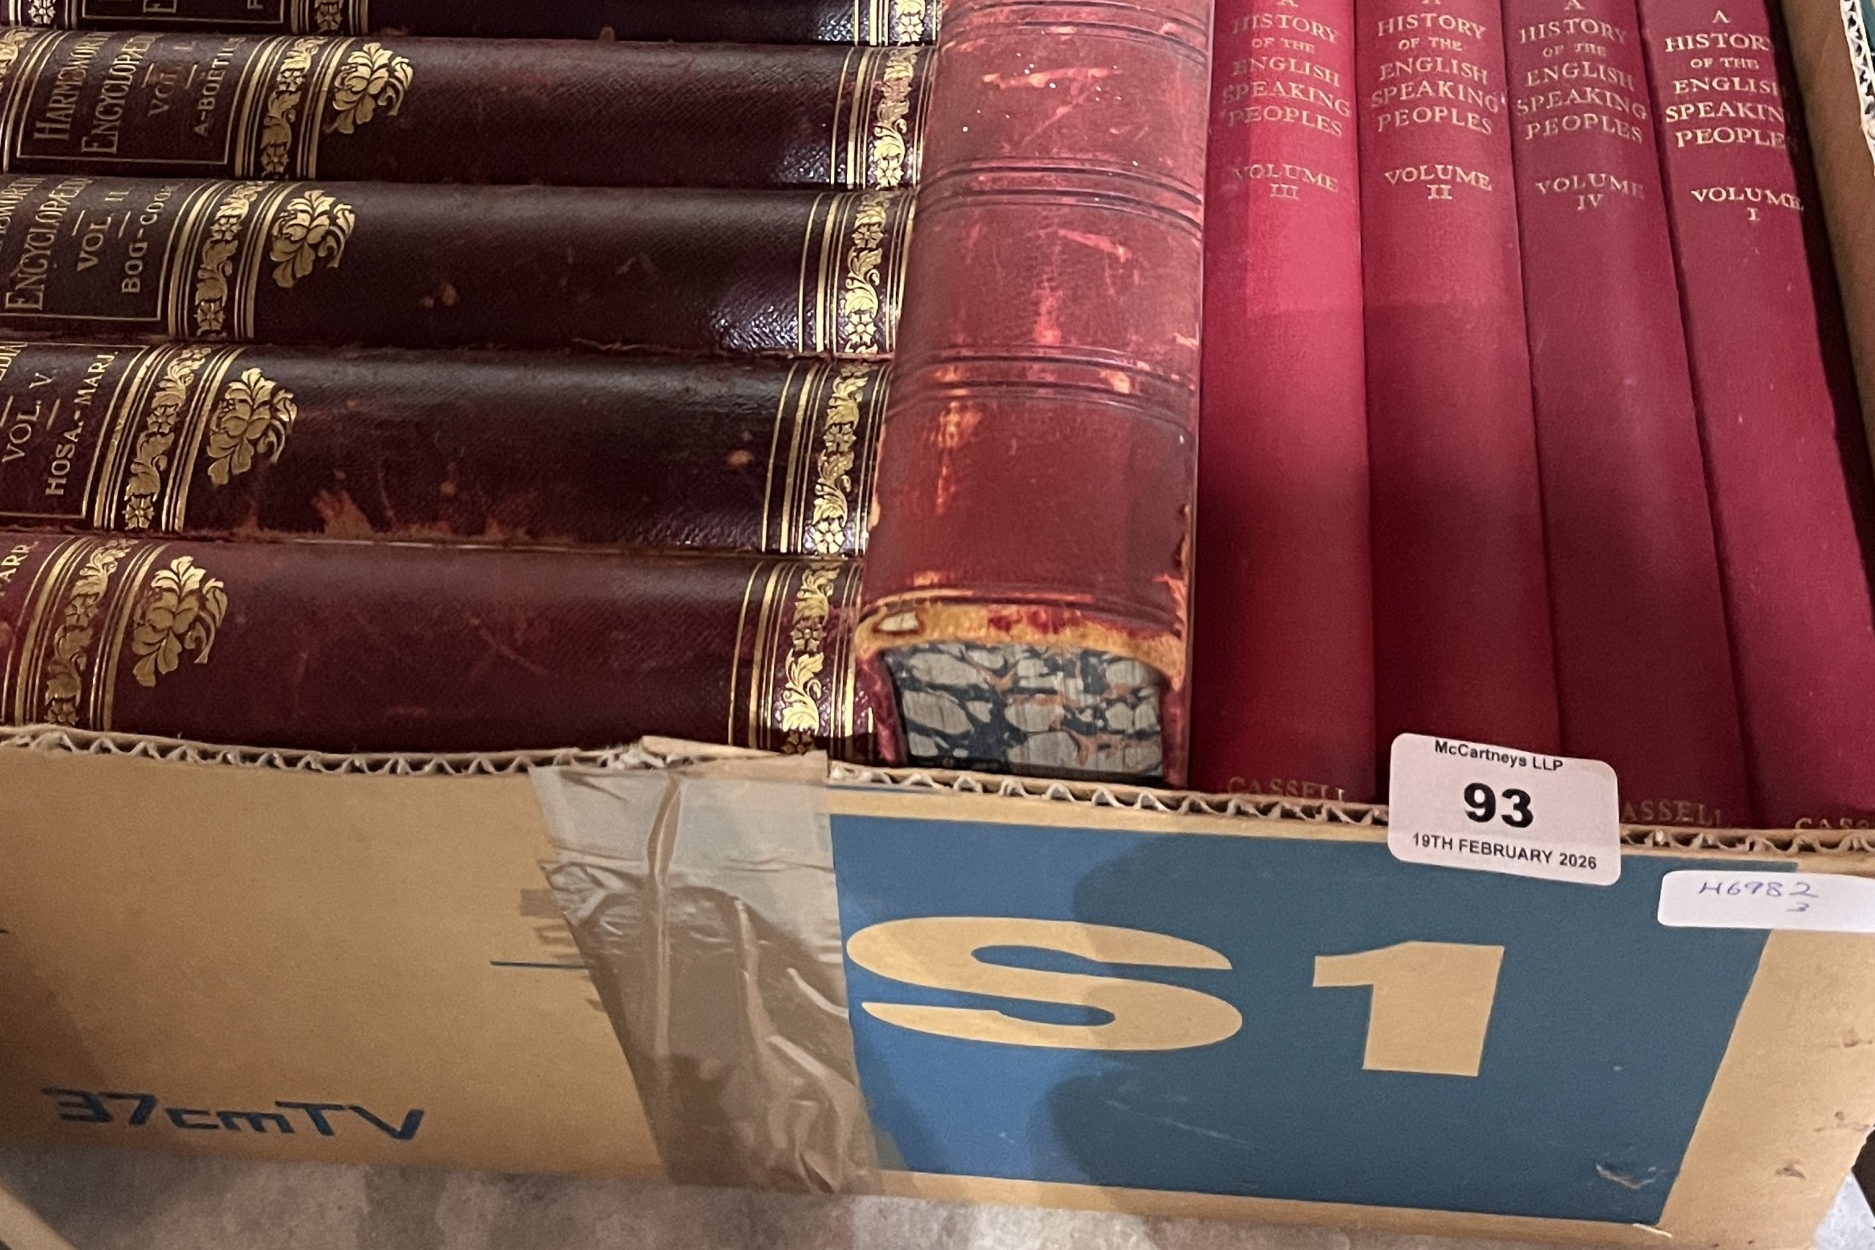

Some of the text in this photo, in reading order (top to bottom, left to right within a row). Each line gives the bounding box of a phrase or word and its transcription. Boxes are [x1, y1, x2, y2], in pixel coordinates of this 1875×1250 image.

[1232, 14, 1338, 44] HISTORY
[1378, 13, 1486, 40] HISTORY
[1712, 9, 1731, 24] A
[1398, 37, 1464, 52] OF THE
[1519, 18, 1626, 44] HISTORY
[1251, 38, 1315, 53] OF THE
[1543, 42, 1607, 58] OF THE
[1233, 57, 1340, 87] ENGLISH
[1380, 56, 1488, 84] ENGLISH
[1525, 61, 1634, 92] ENGLISH
[1690, 57, 1760, 70] OF THE
[1223, 81, 1351, 117] SPEAKING
[1371, 80, 1498, 113] SPEAKING
[1516, 87, 1647, 120] SPEAKING
[1228, 105, 1343, 137] PEOPLES
[1378, 106, 1492, 135] PEOPLES
[1665, 101, 1785, 124] SPEAKIN
[1525, 113, 1642, 144] PEOPLES
[1675, 127, 1787, 149] PEOPLE
[1234, 164, 1338, 192] VOLUME
[1385, 164, 1493, 191] VOLUME
[1535, 173, 1645, 200] VOLUME
[1270, 184, 1300, 200] III
[1427, 184, 1453, 200] II
[1577, 194, 1603, 211] IV
[1691, 187, 1804, 212] VOLUME
[1747, 207, 1760, 222] I
[1434, 739, 1563, 771] McCartneys LLP
[1463, 782, 1534, 829] 93
[1412, 833, 1597, 870] 19TH FEBRUARY 2026
